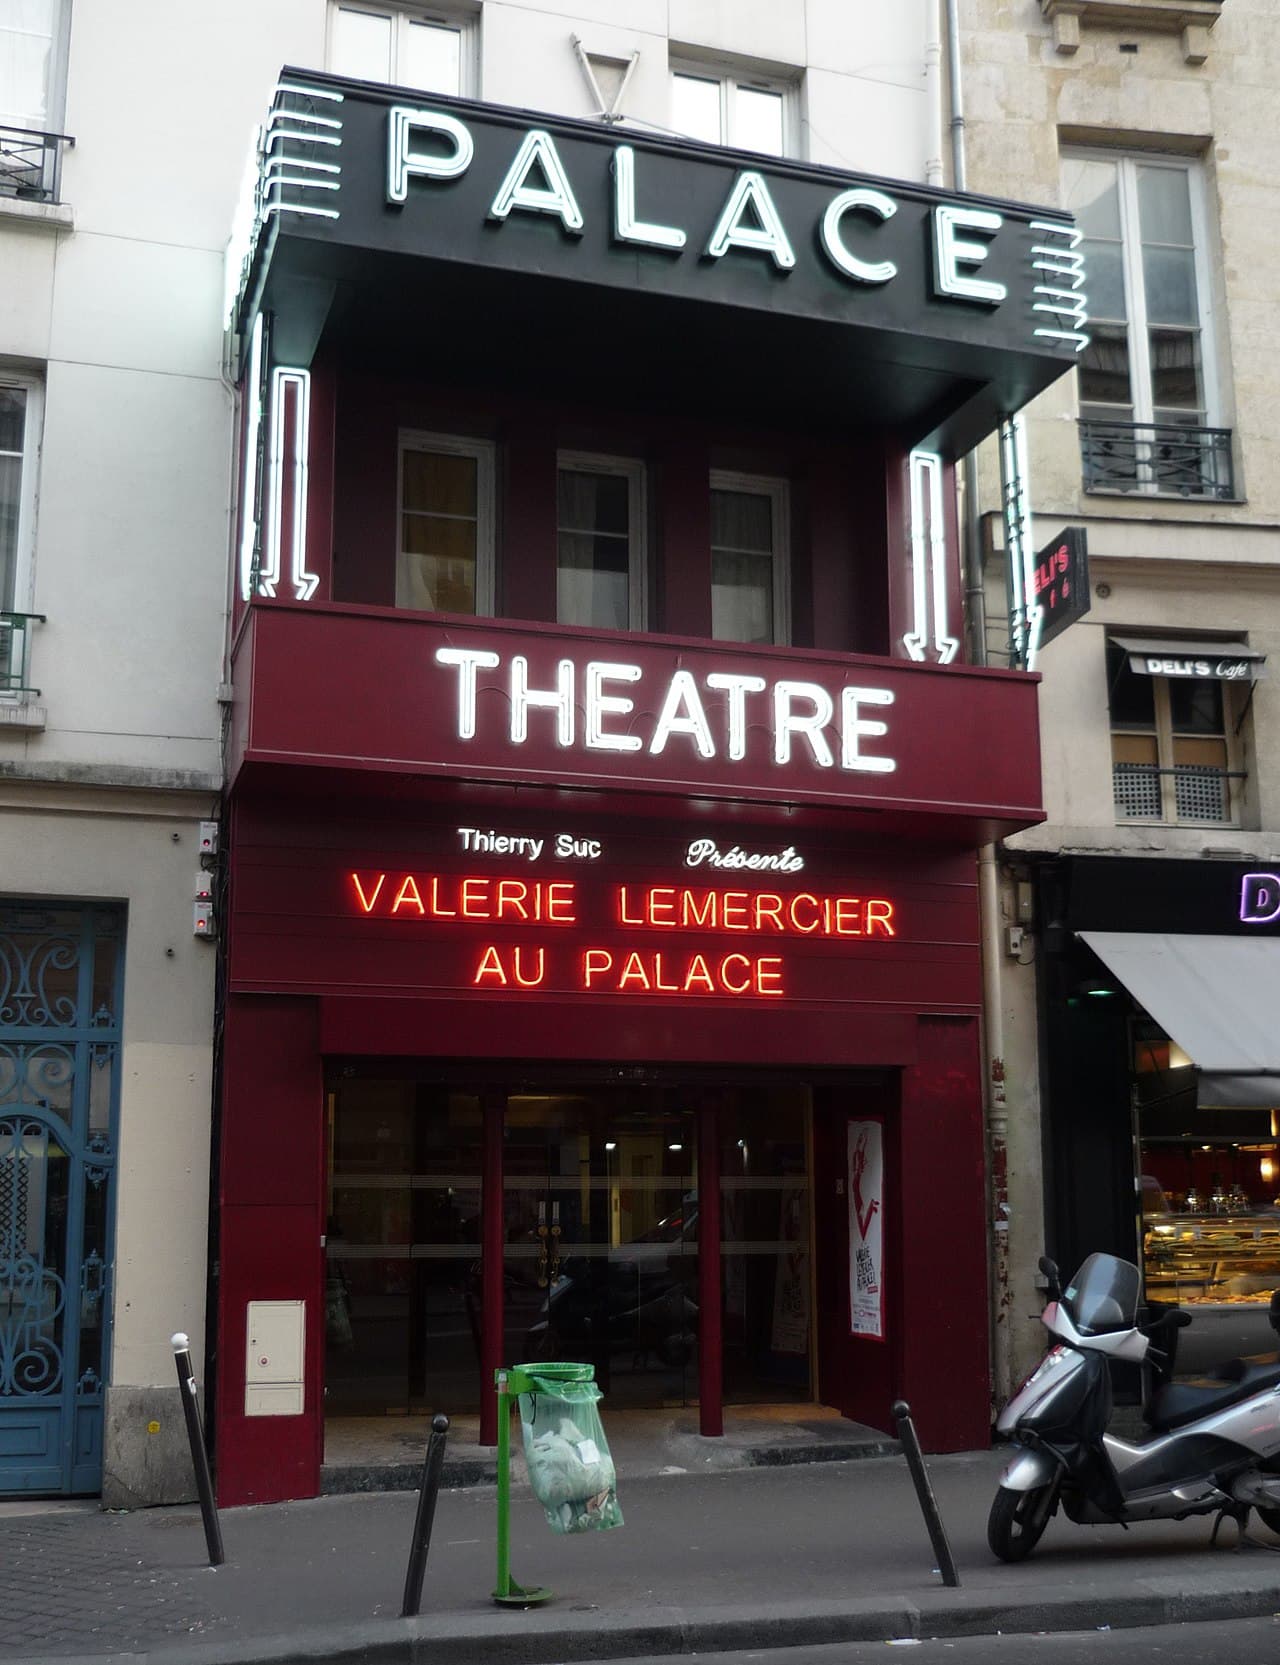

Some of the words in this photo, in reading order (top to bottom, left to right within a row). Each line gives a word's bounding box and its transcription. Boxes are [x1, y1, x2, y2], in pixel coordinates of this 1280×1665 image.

[385, 105, 1009, 305] PALACE
[1146, 659, 1211, 676] DELI'S
[1215, 660, 1249, 680] Café
[435, 647, 897, 774] THEATRE
[458, 828, 543, 861] Thierry
[556, 834, 601, 858] Suc
[686, 839, 804, 873] Présente
[351, 872, 576, 922] VALERIE
[618, 885, 895, 937] LEMERCIER
[473, 946, 545, 986] AU
[584, 950, 785, 995] PALACE
